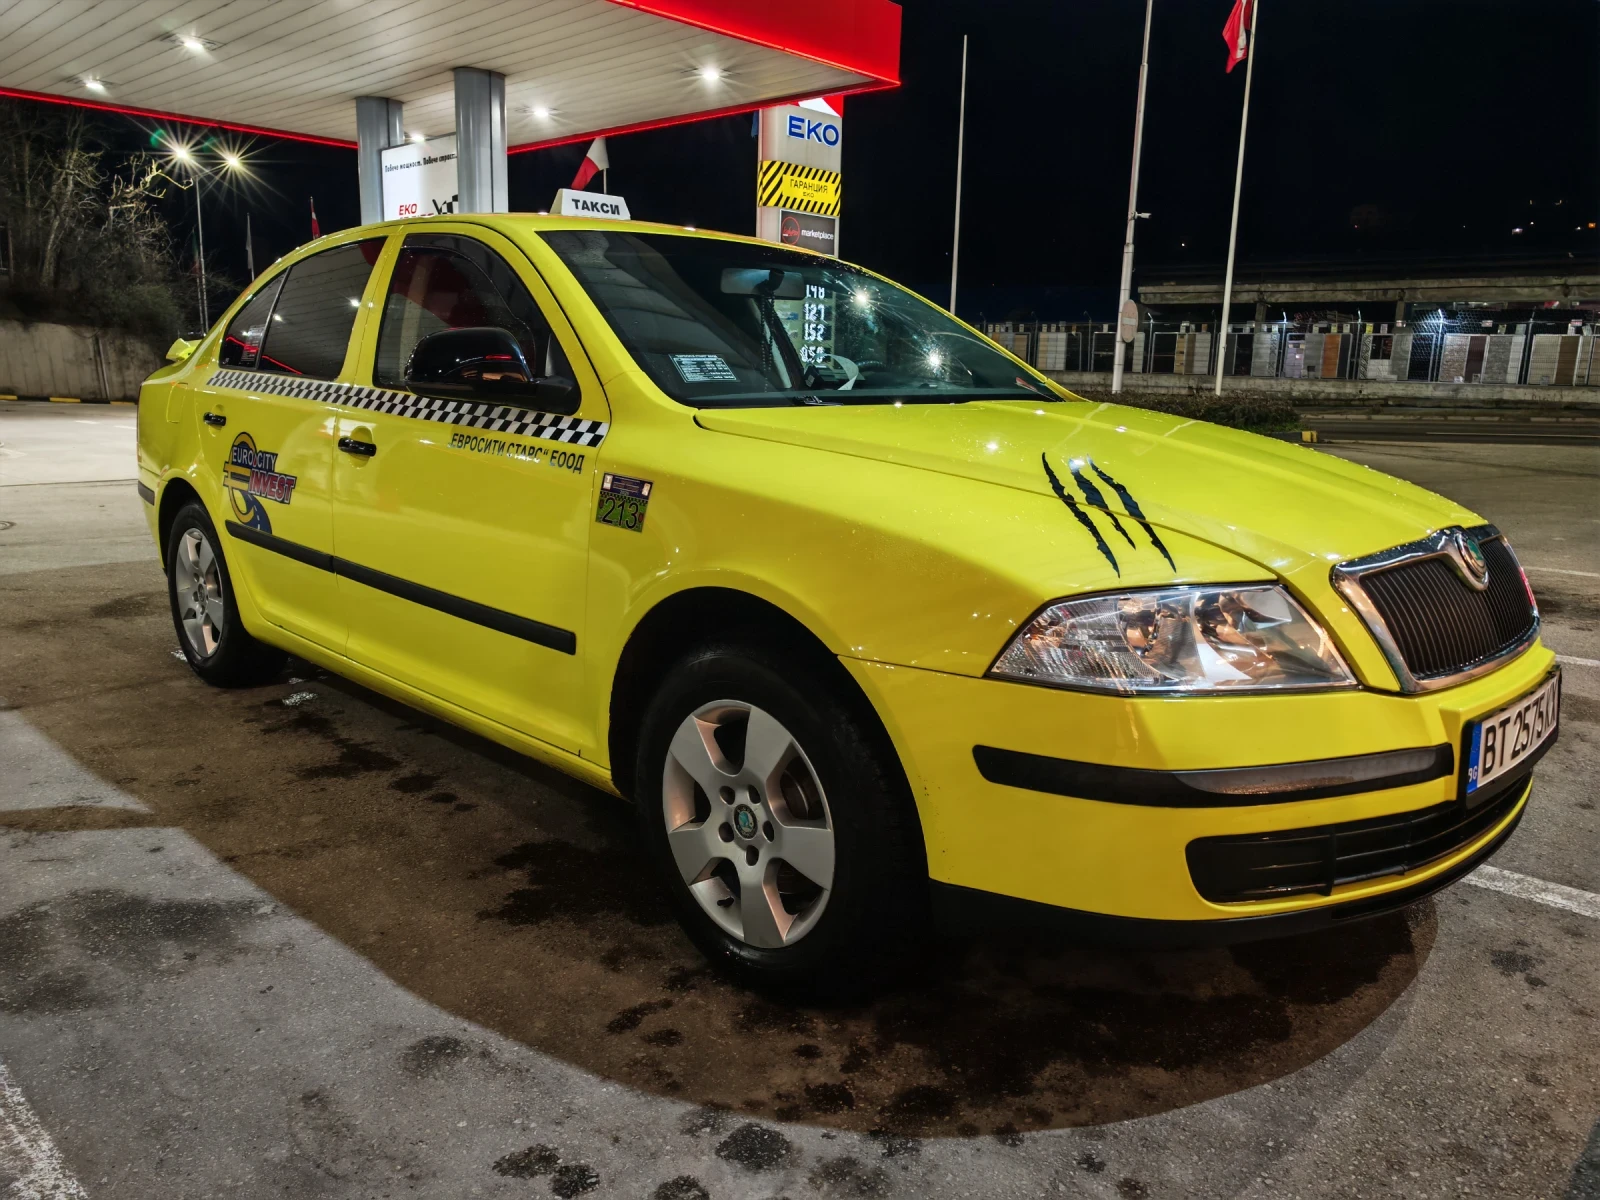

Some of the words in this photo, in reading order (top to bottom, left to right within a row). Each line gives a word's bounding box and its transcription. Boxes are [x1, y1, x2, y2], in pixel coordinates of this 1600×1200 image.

[787, 114, 840, 147] EKO
[789, 178, 828, 194] ГАРАНЦИЯ
[398, 203, 418, 216] EKO
[571, 198, 620, 216] ТАКСИ
[801, 229, 834, 240] marketplace
[248, 468, 296, 504] INVEST
[601, 496, 639, 529] 213
[1482, 715, 1511, 778] BT
